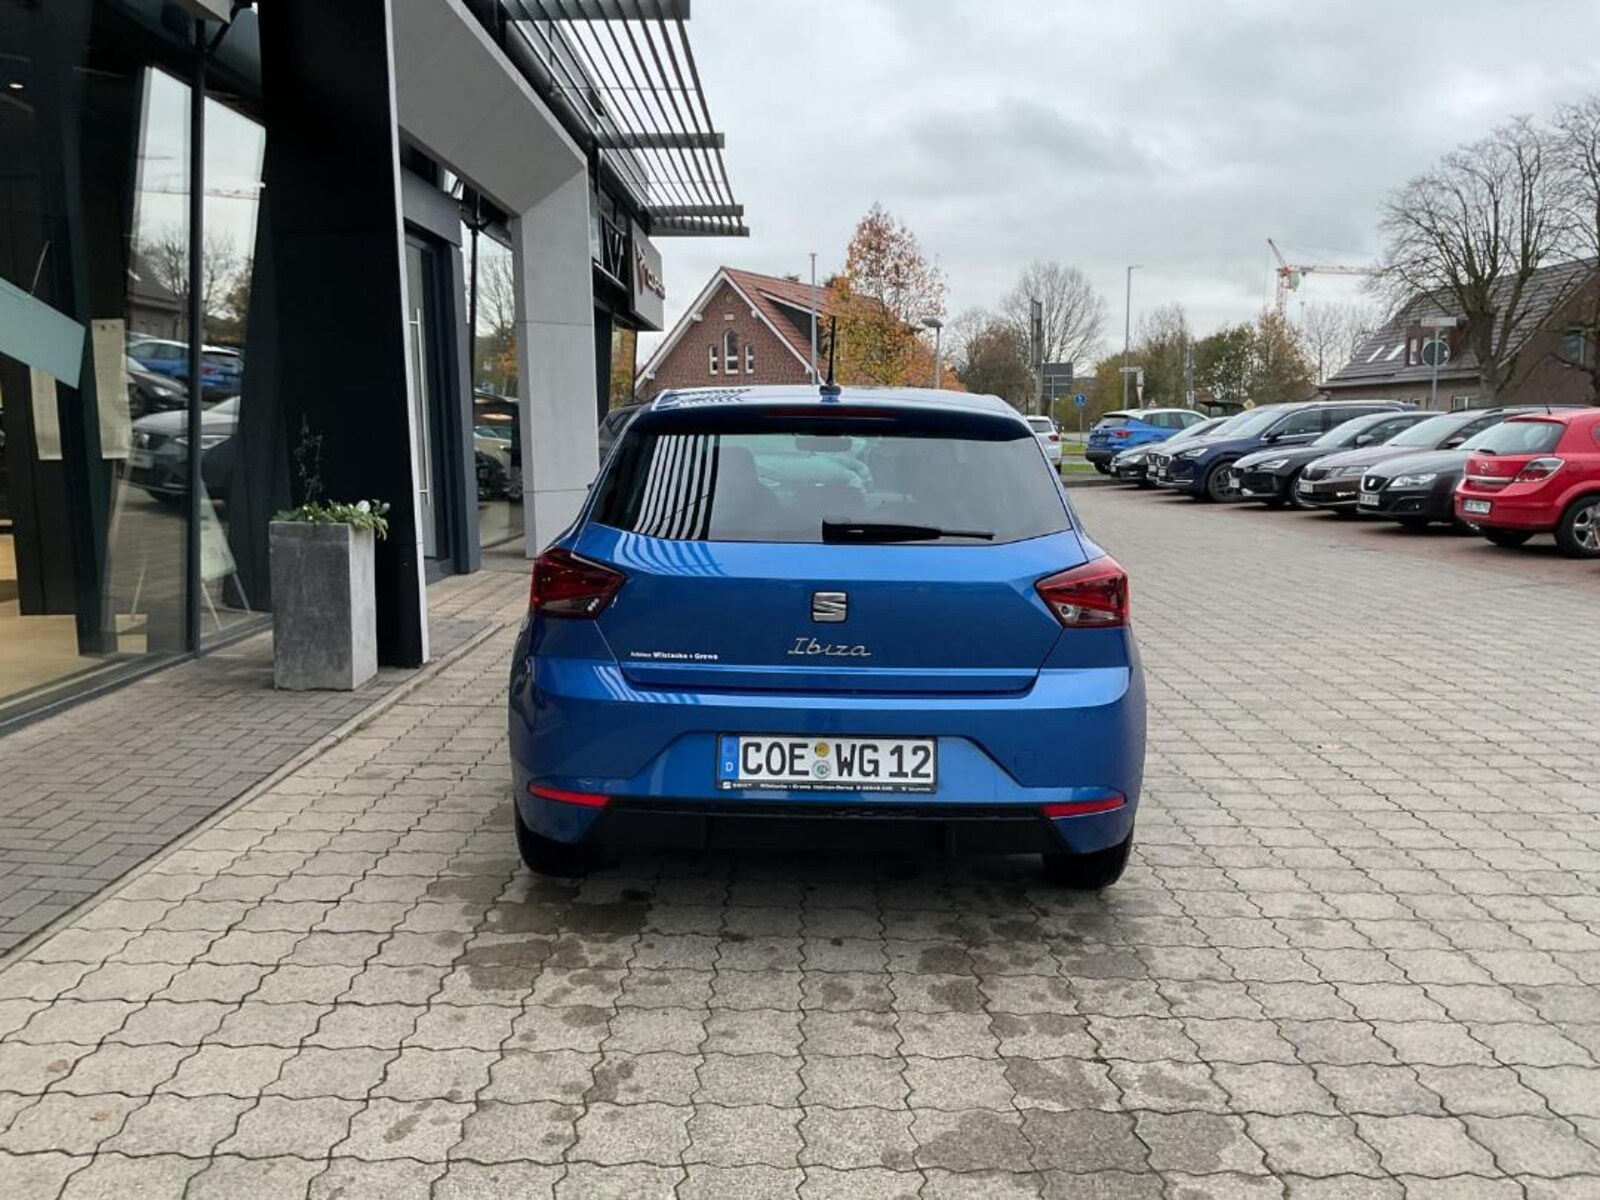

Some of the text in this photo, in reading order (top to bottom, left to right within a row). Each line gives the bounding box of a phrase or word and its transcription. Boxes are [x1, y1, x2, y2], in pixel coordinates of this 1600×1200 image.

[787, 637, 872, 656] Ibiza
[742, 741, 931, 778] COE WG 12
